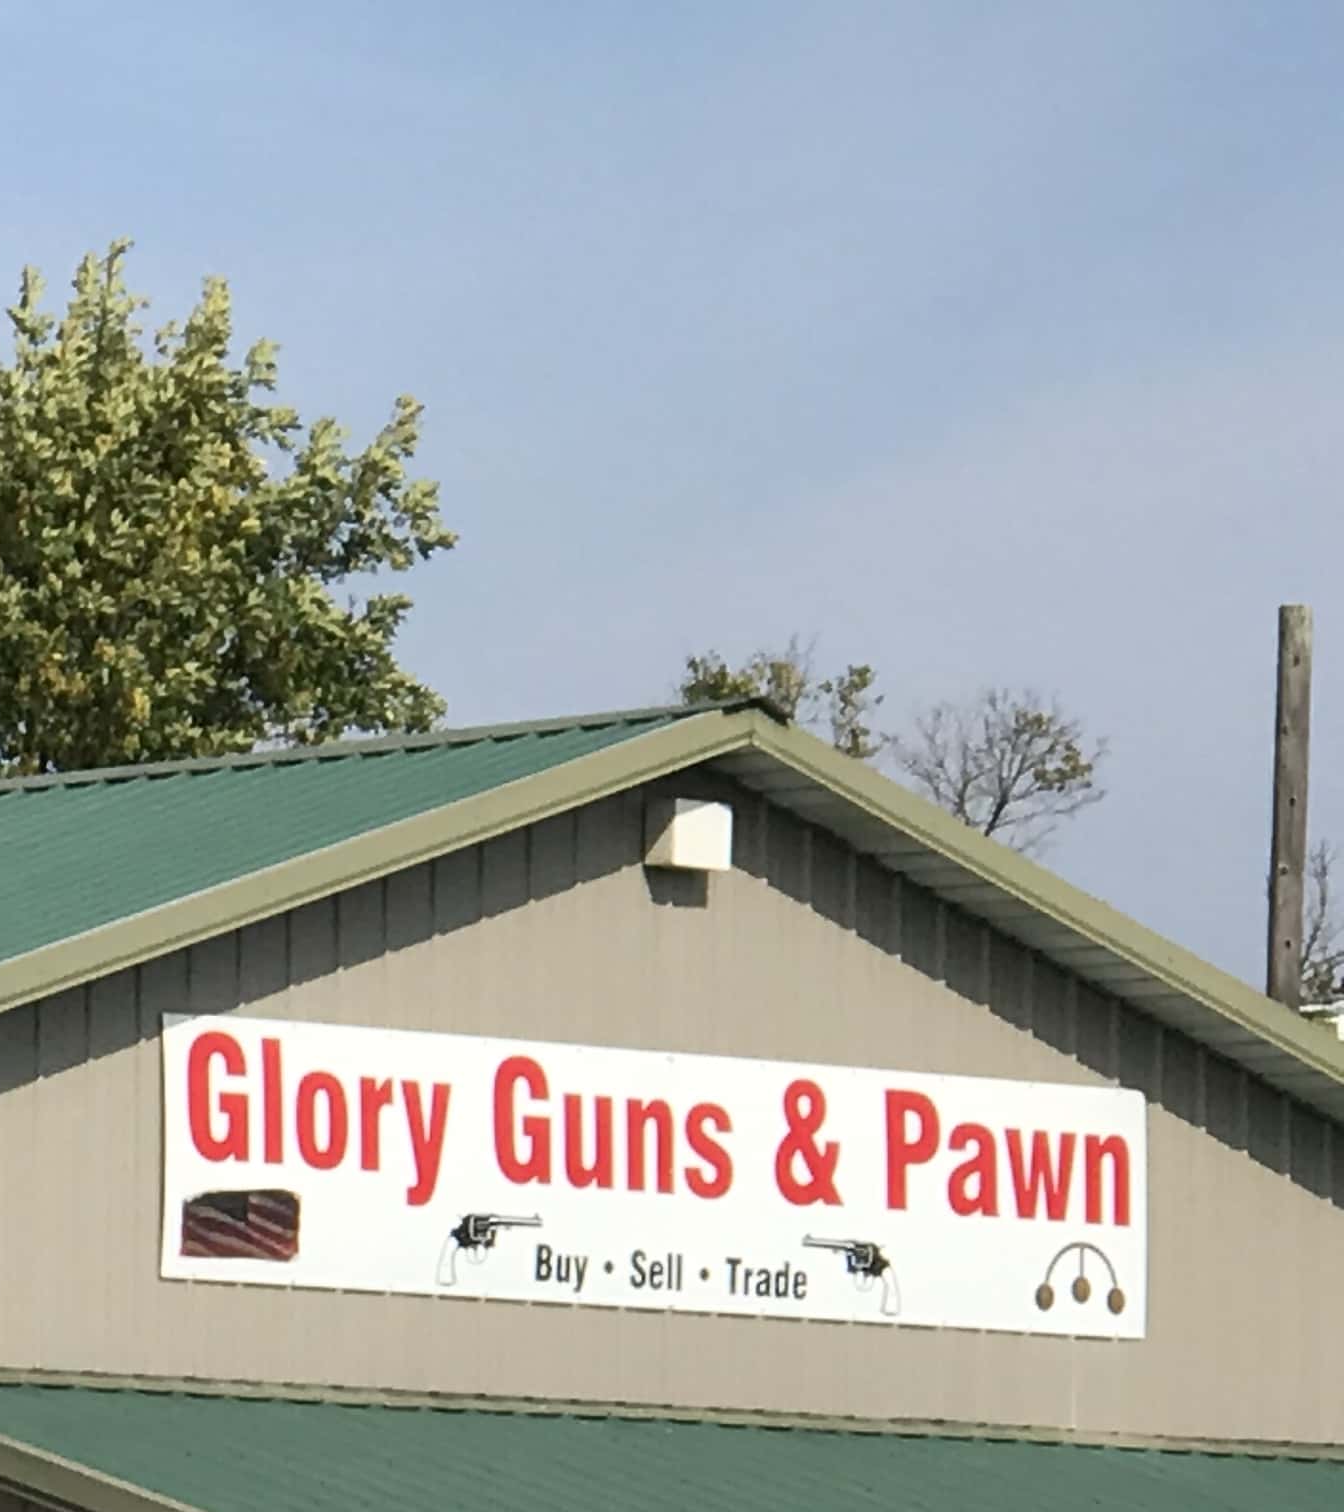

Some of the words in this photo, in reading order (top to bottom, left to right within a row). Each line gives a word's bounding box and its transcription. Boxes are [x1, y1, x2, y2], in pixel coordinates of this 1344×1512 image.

[187, 1031, 449, 1206] Glory
[493, 1056, 732, 1199] Guns
[774, 1079, 840, 1205] &
[885, 1089, 1129, 1225] Pawn
[535, 1244, 588, 1293] Buy
[630, 1250, 683, 1291] Sell
[726, 1258, 808, 1300] Trade
